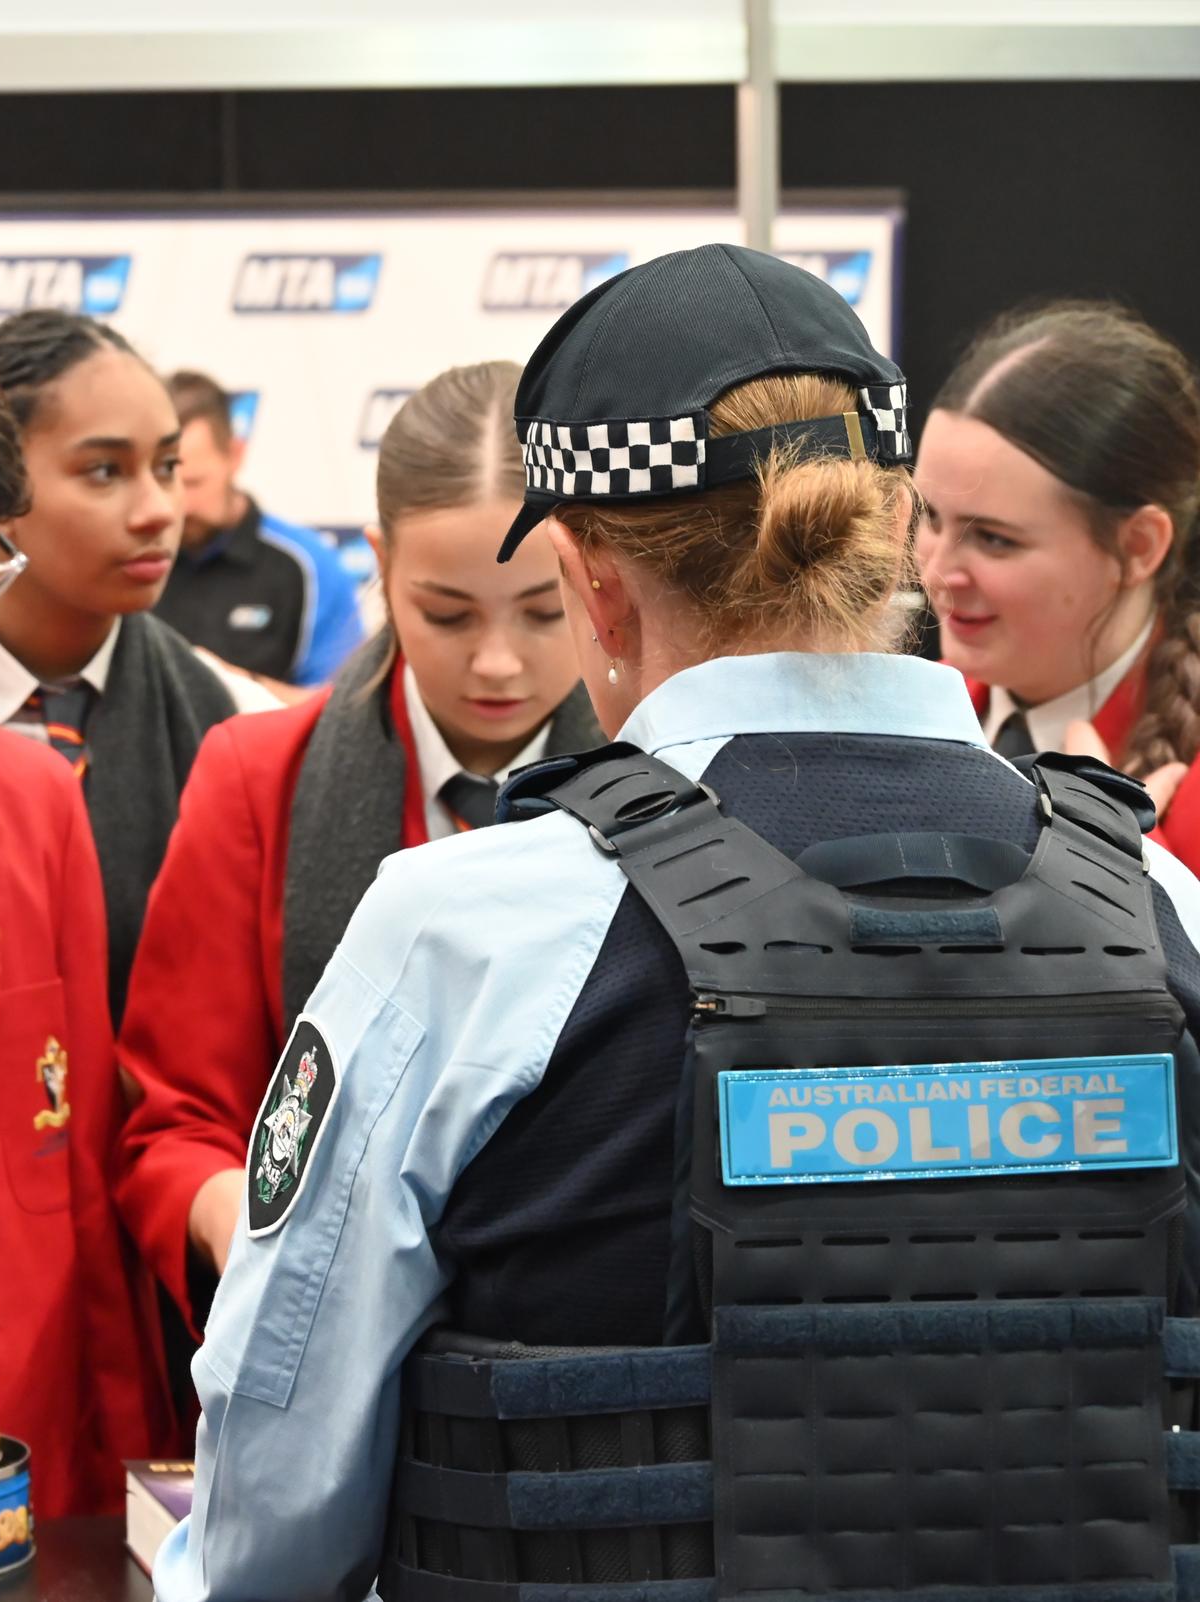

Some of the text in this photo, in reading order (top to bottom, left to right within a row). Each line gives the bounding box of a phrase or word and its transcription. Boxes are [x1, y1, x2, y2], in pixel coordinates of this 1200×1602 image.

[234, 259, 335, 308] MTA
[767, 1073, 1126, 1108] AUSTRALIAN FEDERAL
[768, 1099, 1128, 1168] POLICE
